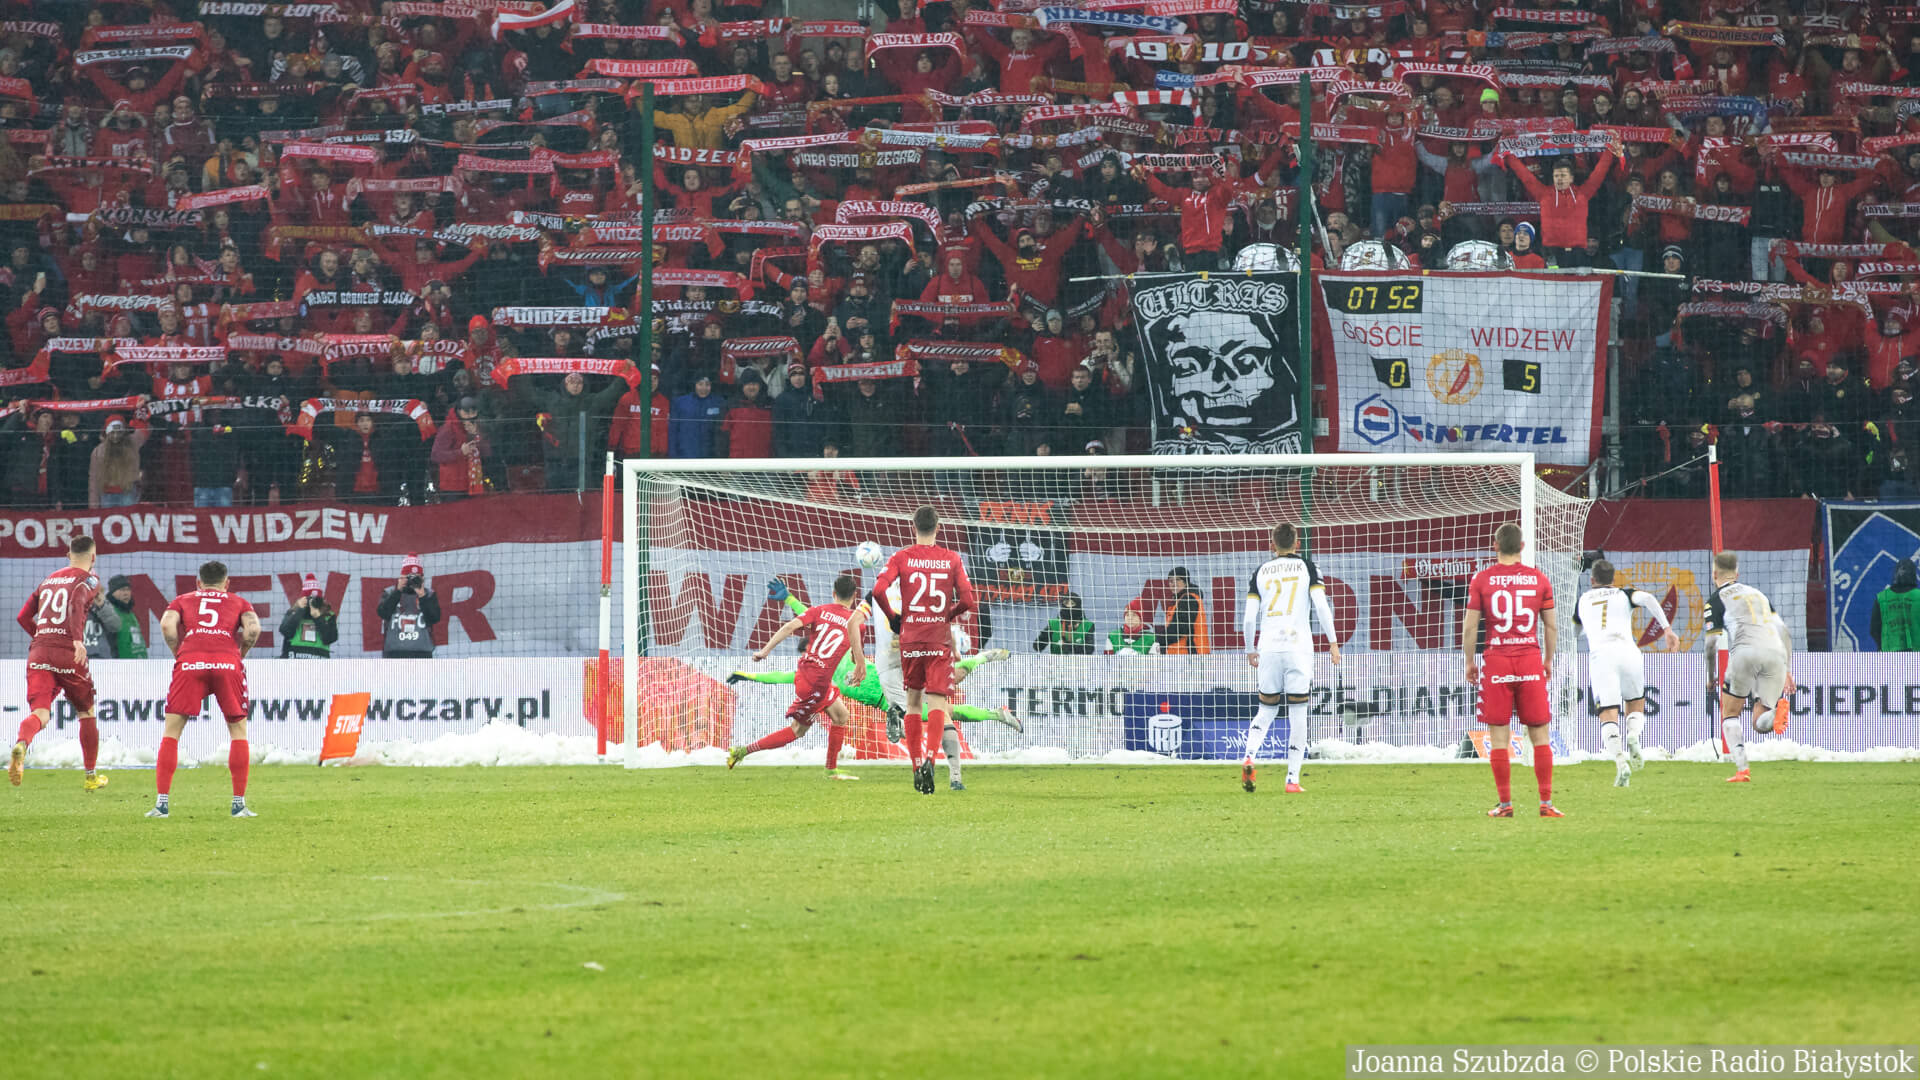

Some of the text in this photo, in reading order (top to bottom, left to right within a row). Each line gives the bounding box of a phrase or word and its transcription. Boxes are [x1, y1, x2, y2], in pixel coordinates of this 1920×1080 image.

[591, 25, 662, 36] RADOMSKO
[871, 34, 923, 45] WIDZEW
[1403, 62, 1458, 73] WIDZEW
[422, 103, 443, 115] FC
[1782, 152, 1881, 169] WIDZEW
[816, 226, 869, 238] WIDZEW
[1134, 278, 1289, 319] ULTRAS
[1347, 286, 1419, 311] 07 52
[511, 309, 604, 326] WIDZEW
[1341, 320, 1576, 352] GOŚCIE WIDZEW
[324, 342, 392, 361] WIDZEW
[822, 363, 905, 380] WIDZEW
[1390, 360, 1536, 392] 0 5
[210, 508, 389, 545] WIDZEW
[907, 558, 952, 570] HANOUSEK
[1489, 573, 1538, 587] STĘPIŃSKI
[908, 572, 949, 613] 25
[1264, 576, 1300, 617] 27
[37, 587, 69, 625] 29
[198, 598, 222, 628] 5
[1490, 590, 1537, 633] 95
[1591, 599, 1609, 631] 7
[398, 631, 420, 641] 049
[811, 623, 845, 659] 10
[333, 715, 361, 735] STIHL
